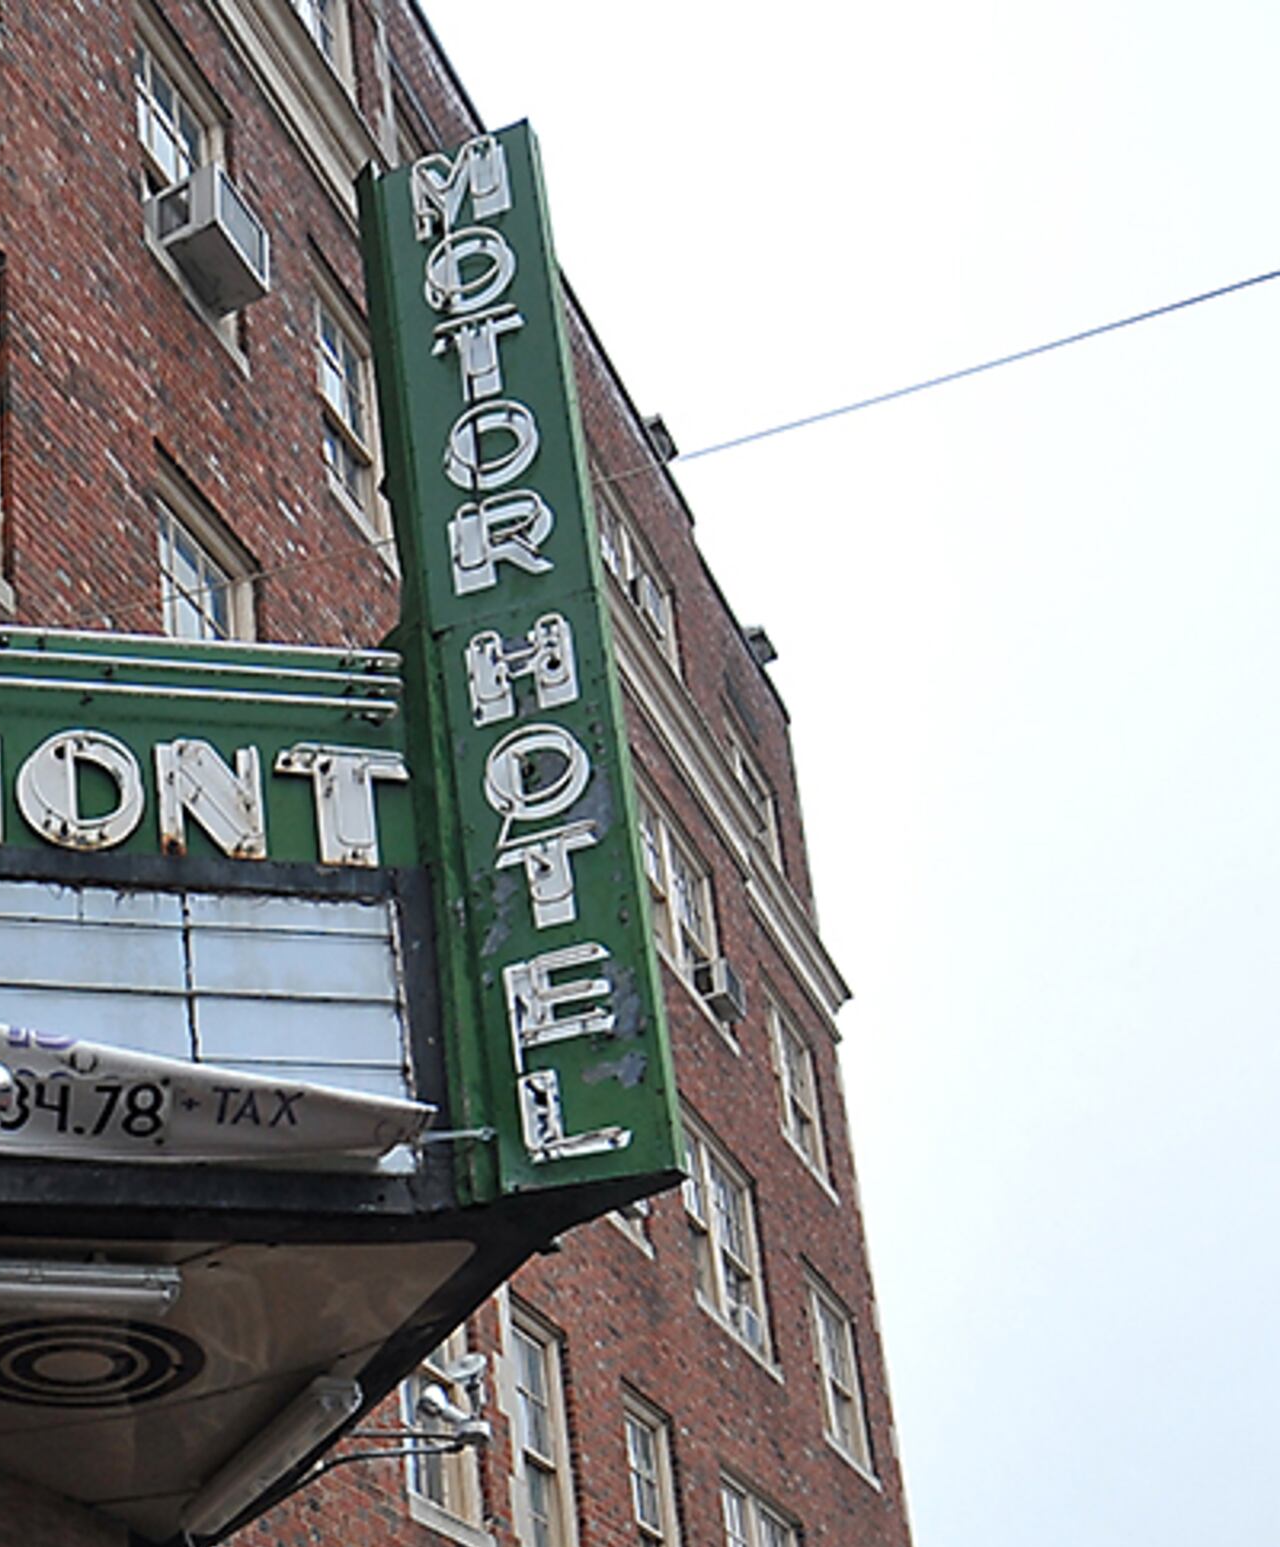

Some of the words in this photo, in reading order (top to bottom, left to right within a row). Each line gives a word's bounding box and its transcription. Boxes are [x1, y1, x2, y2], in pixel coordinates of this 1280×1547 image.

[410, 134, 555, 597] MOTOR
[212, 1085, 306, 1128] TAX
[465, 611, 632, 1164] HOTEL
